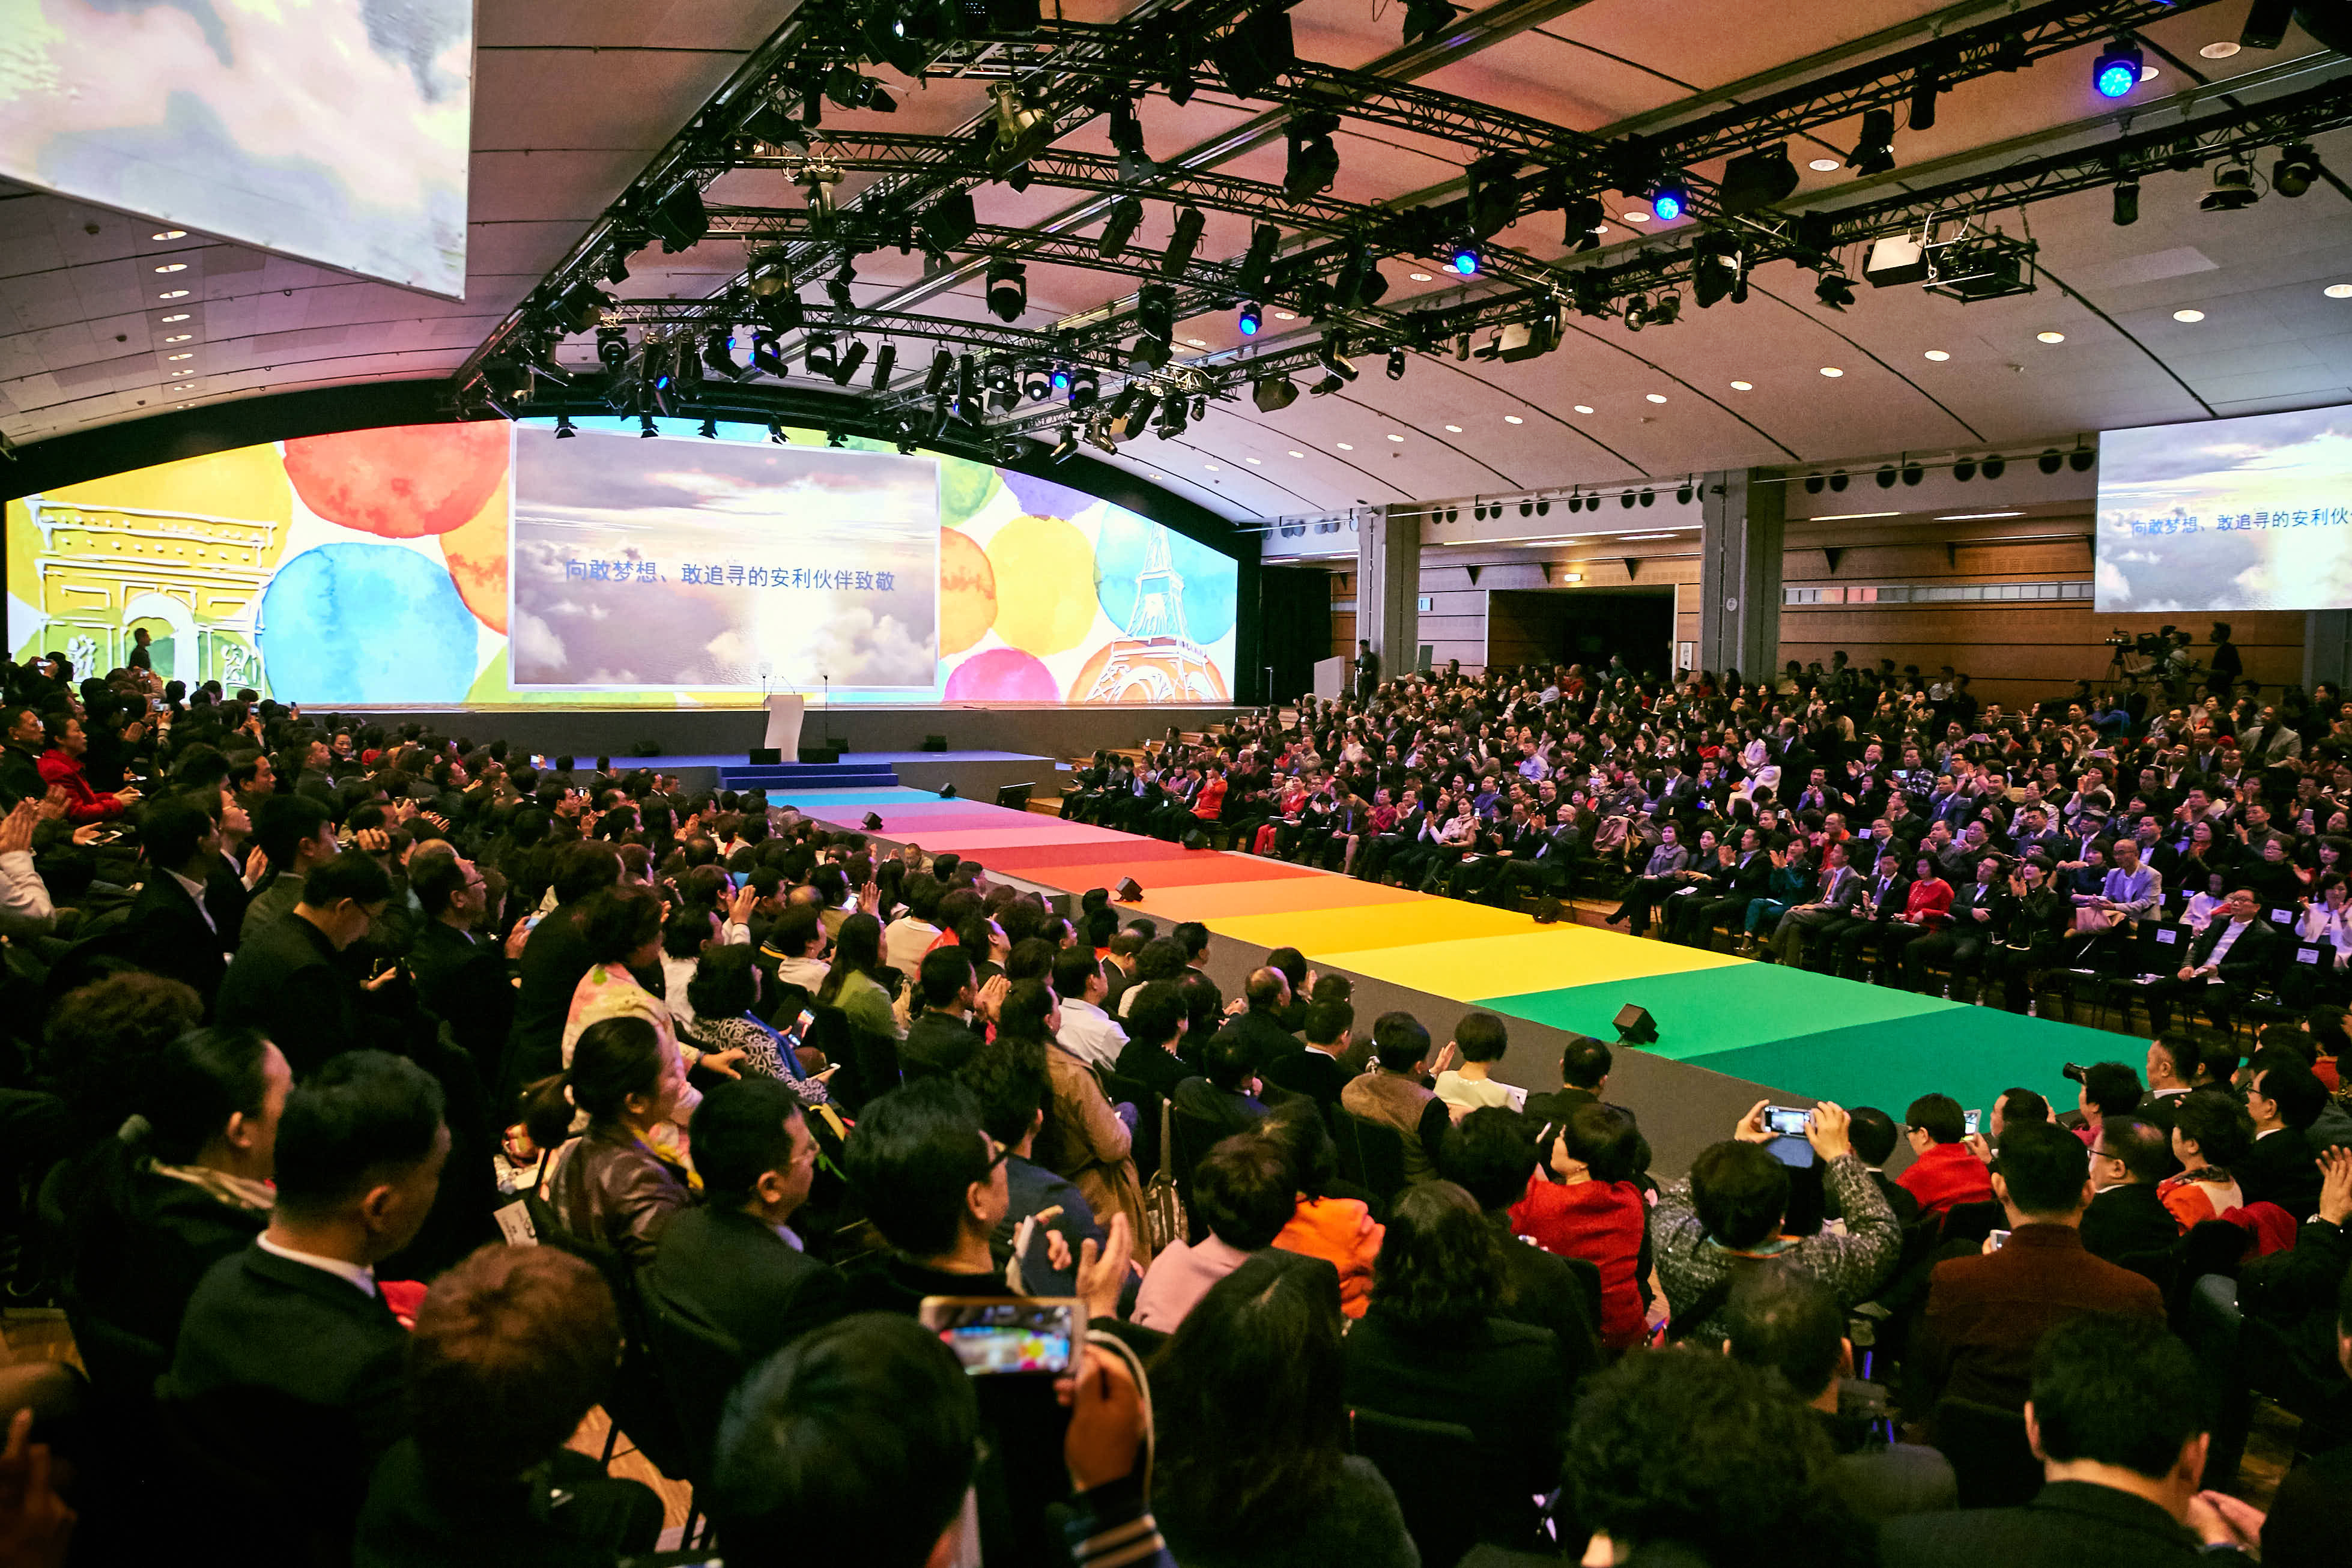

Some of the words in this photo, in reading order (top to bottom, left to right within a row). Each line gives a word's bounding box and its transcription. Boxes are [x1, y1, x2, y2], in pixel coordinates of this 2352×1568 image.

[2132, 507, 2352, 536] 向敢梦想、敢追寻的安利伙
[566, 558, 894, 591] 向敢梦想、敢追寻的安利伙伴致敬
